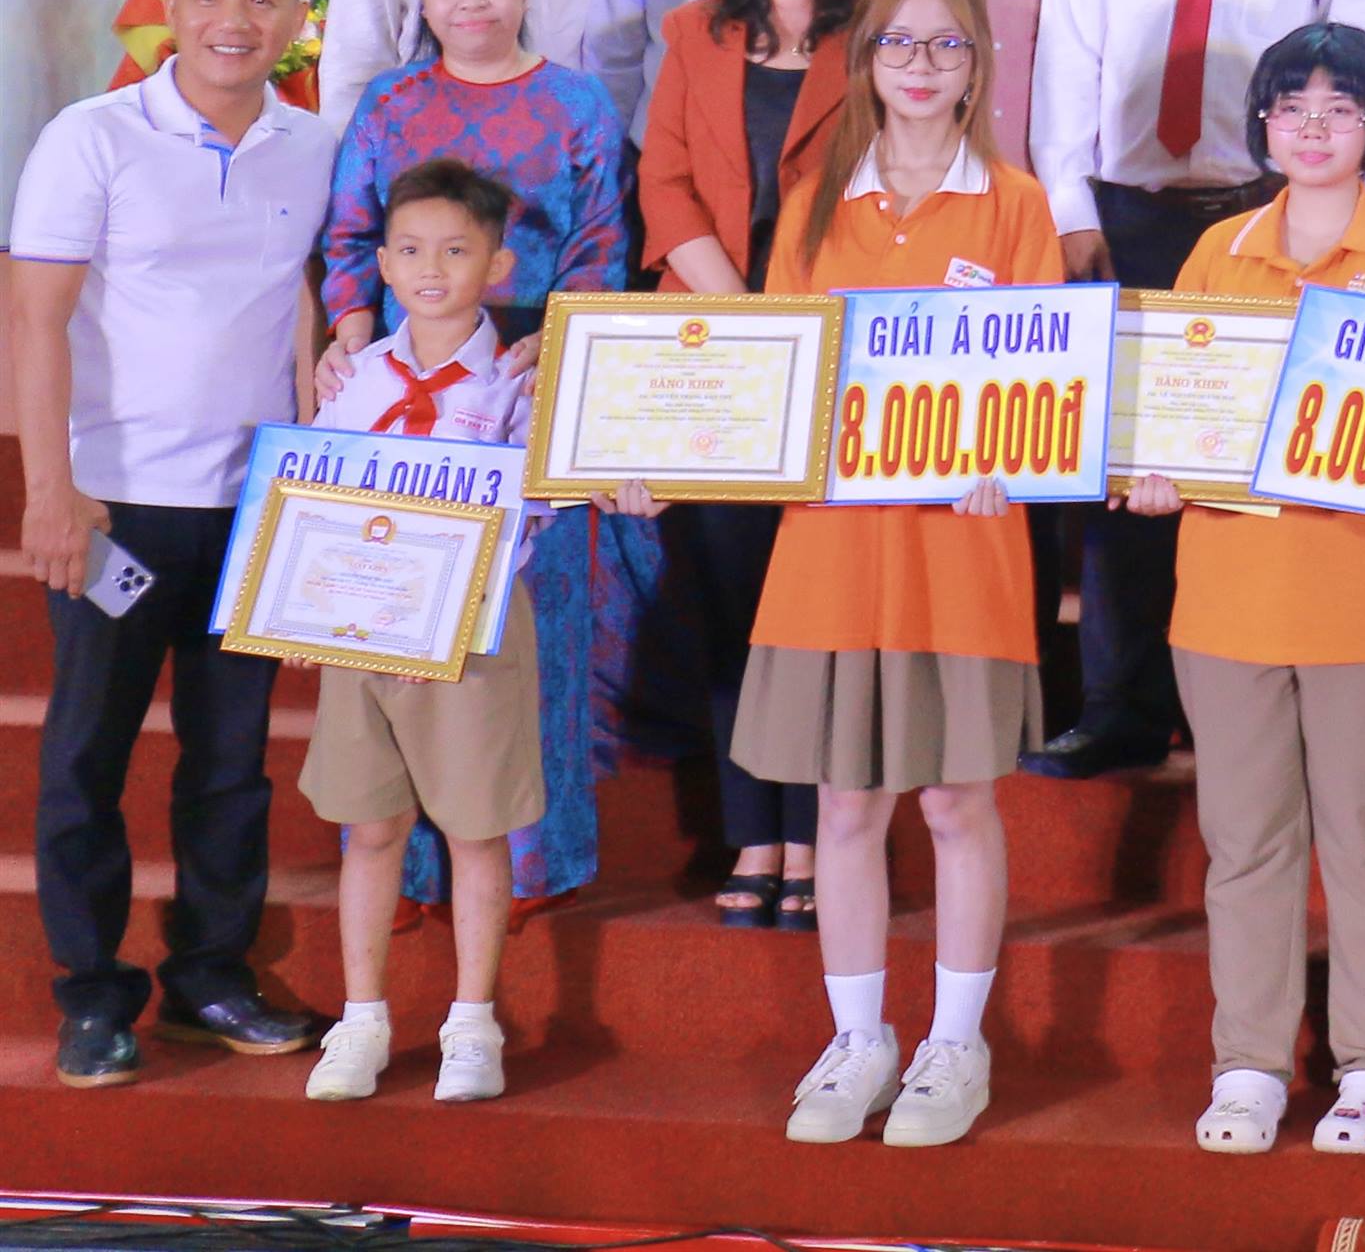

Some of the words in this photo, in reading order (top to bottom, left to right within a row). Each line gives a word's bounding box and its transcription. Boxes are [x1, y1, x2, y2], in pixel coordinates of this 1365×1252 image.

[868, 301, 933, 357] GIẢI
[950, 312, 970, 356] Á
[982, 303, 1071, 359] QUÂN
[688, 378, 725, 390] KHEN
[1193, 377, 1229, 390] KHEN
[838, 379, 1086, 479] 8.000.000đ
[278, 441, 344, 486] GIẢI
[361, 450, 376, 490] Á
[388, 457, 476, 504] QUÂN
[482, 469, 503, 506] 3
